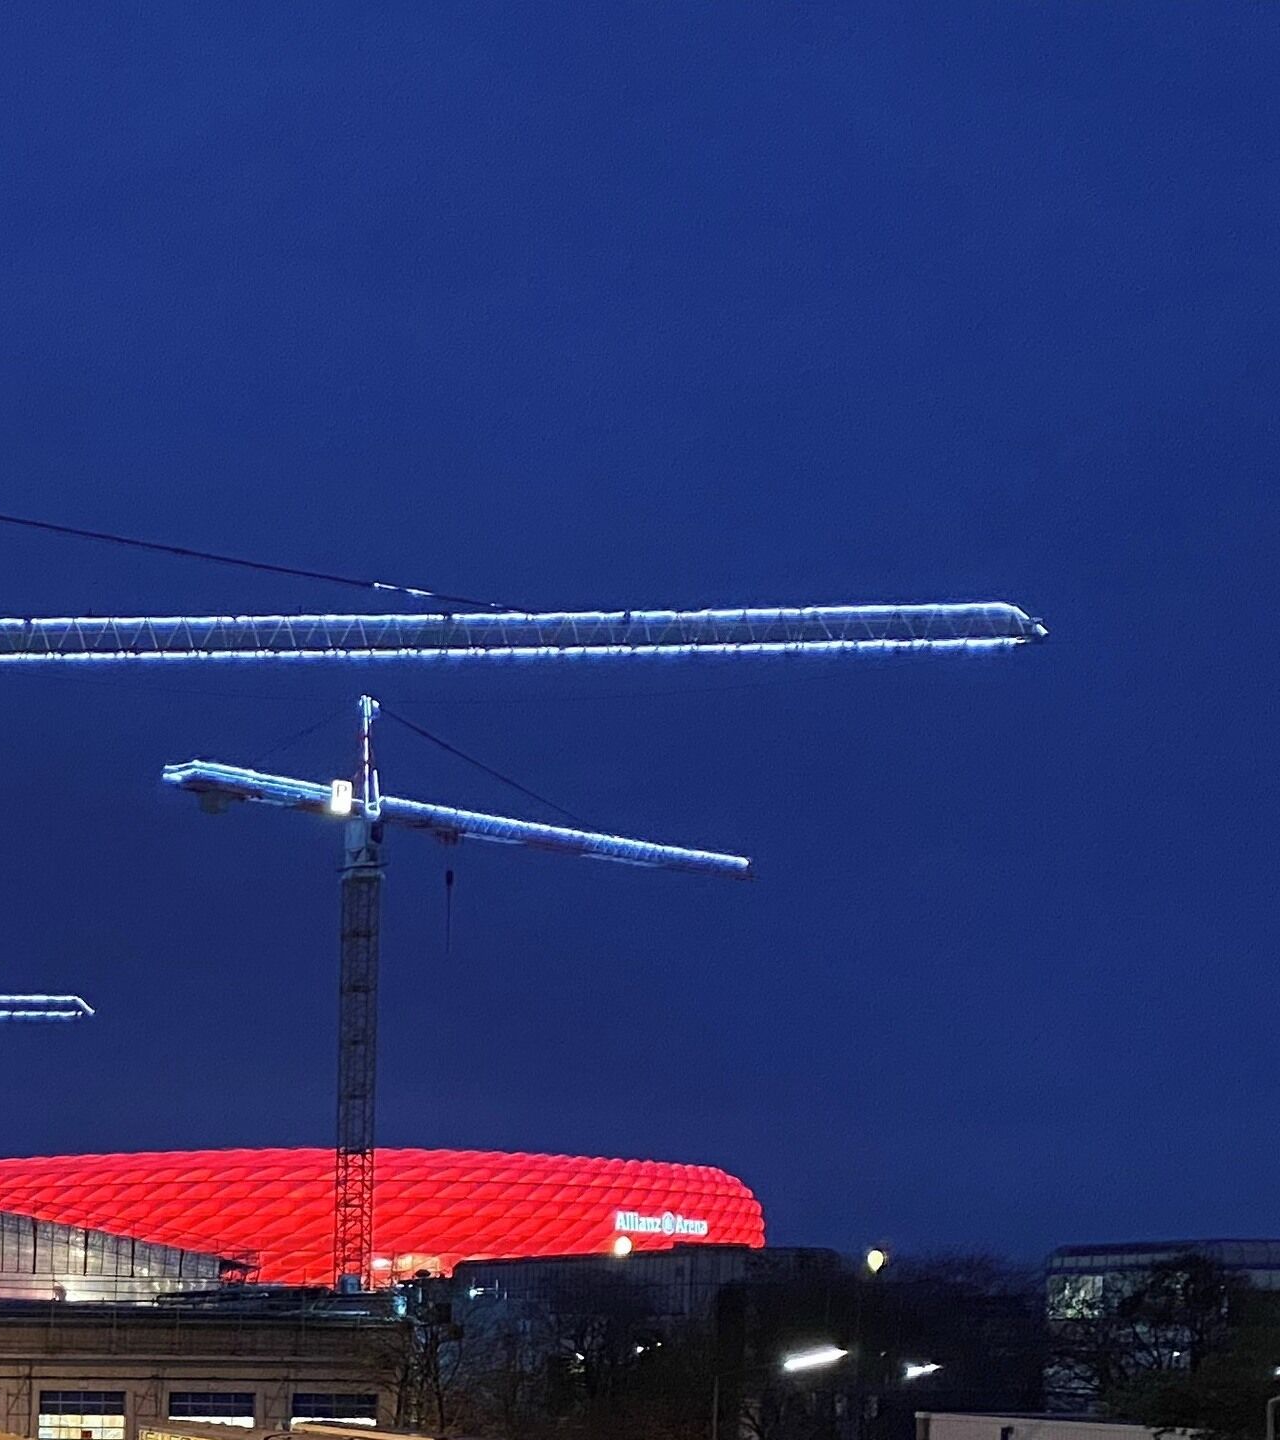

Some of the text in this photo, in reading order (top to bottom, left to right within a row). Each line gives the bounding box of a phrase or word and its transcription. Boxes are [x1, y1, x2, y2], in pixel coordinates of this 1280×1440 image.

[336, 784, 348, 798] P
[615, 1210, 708, 1236] Allianz Arena
